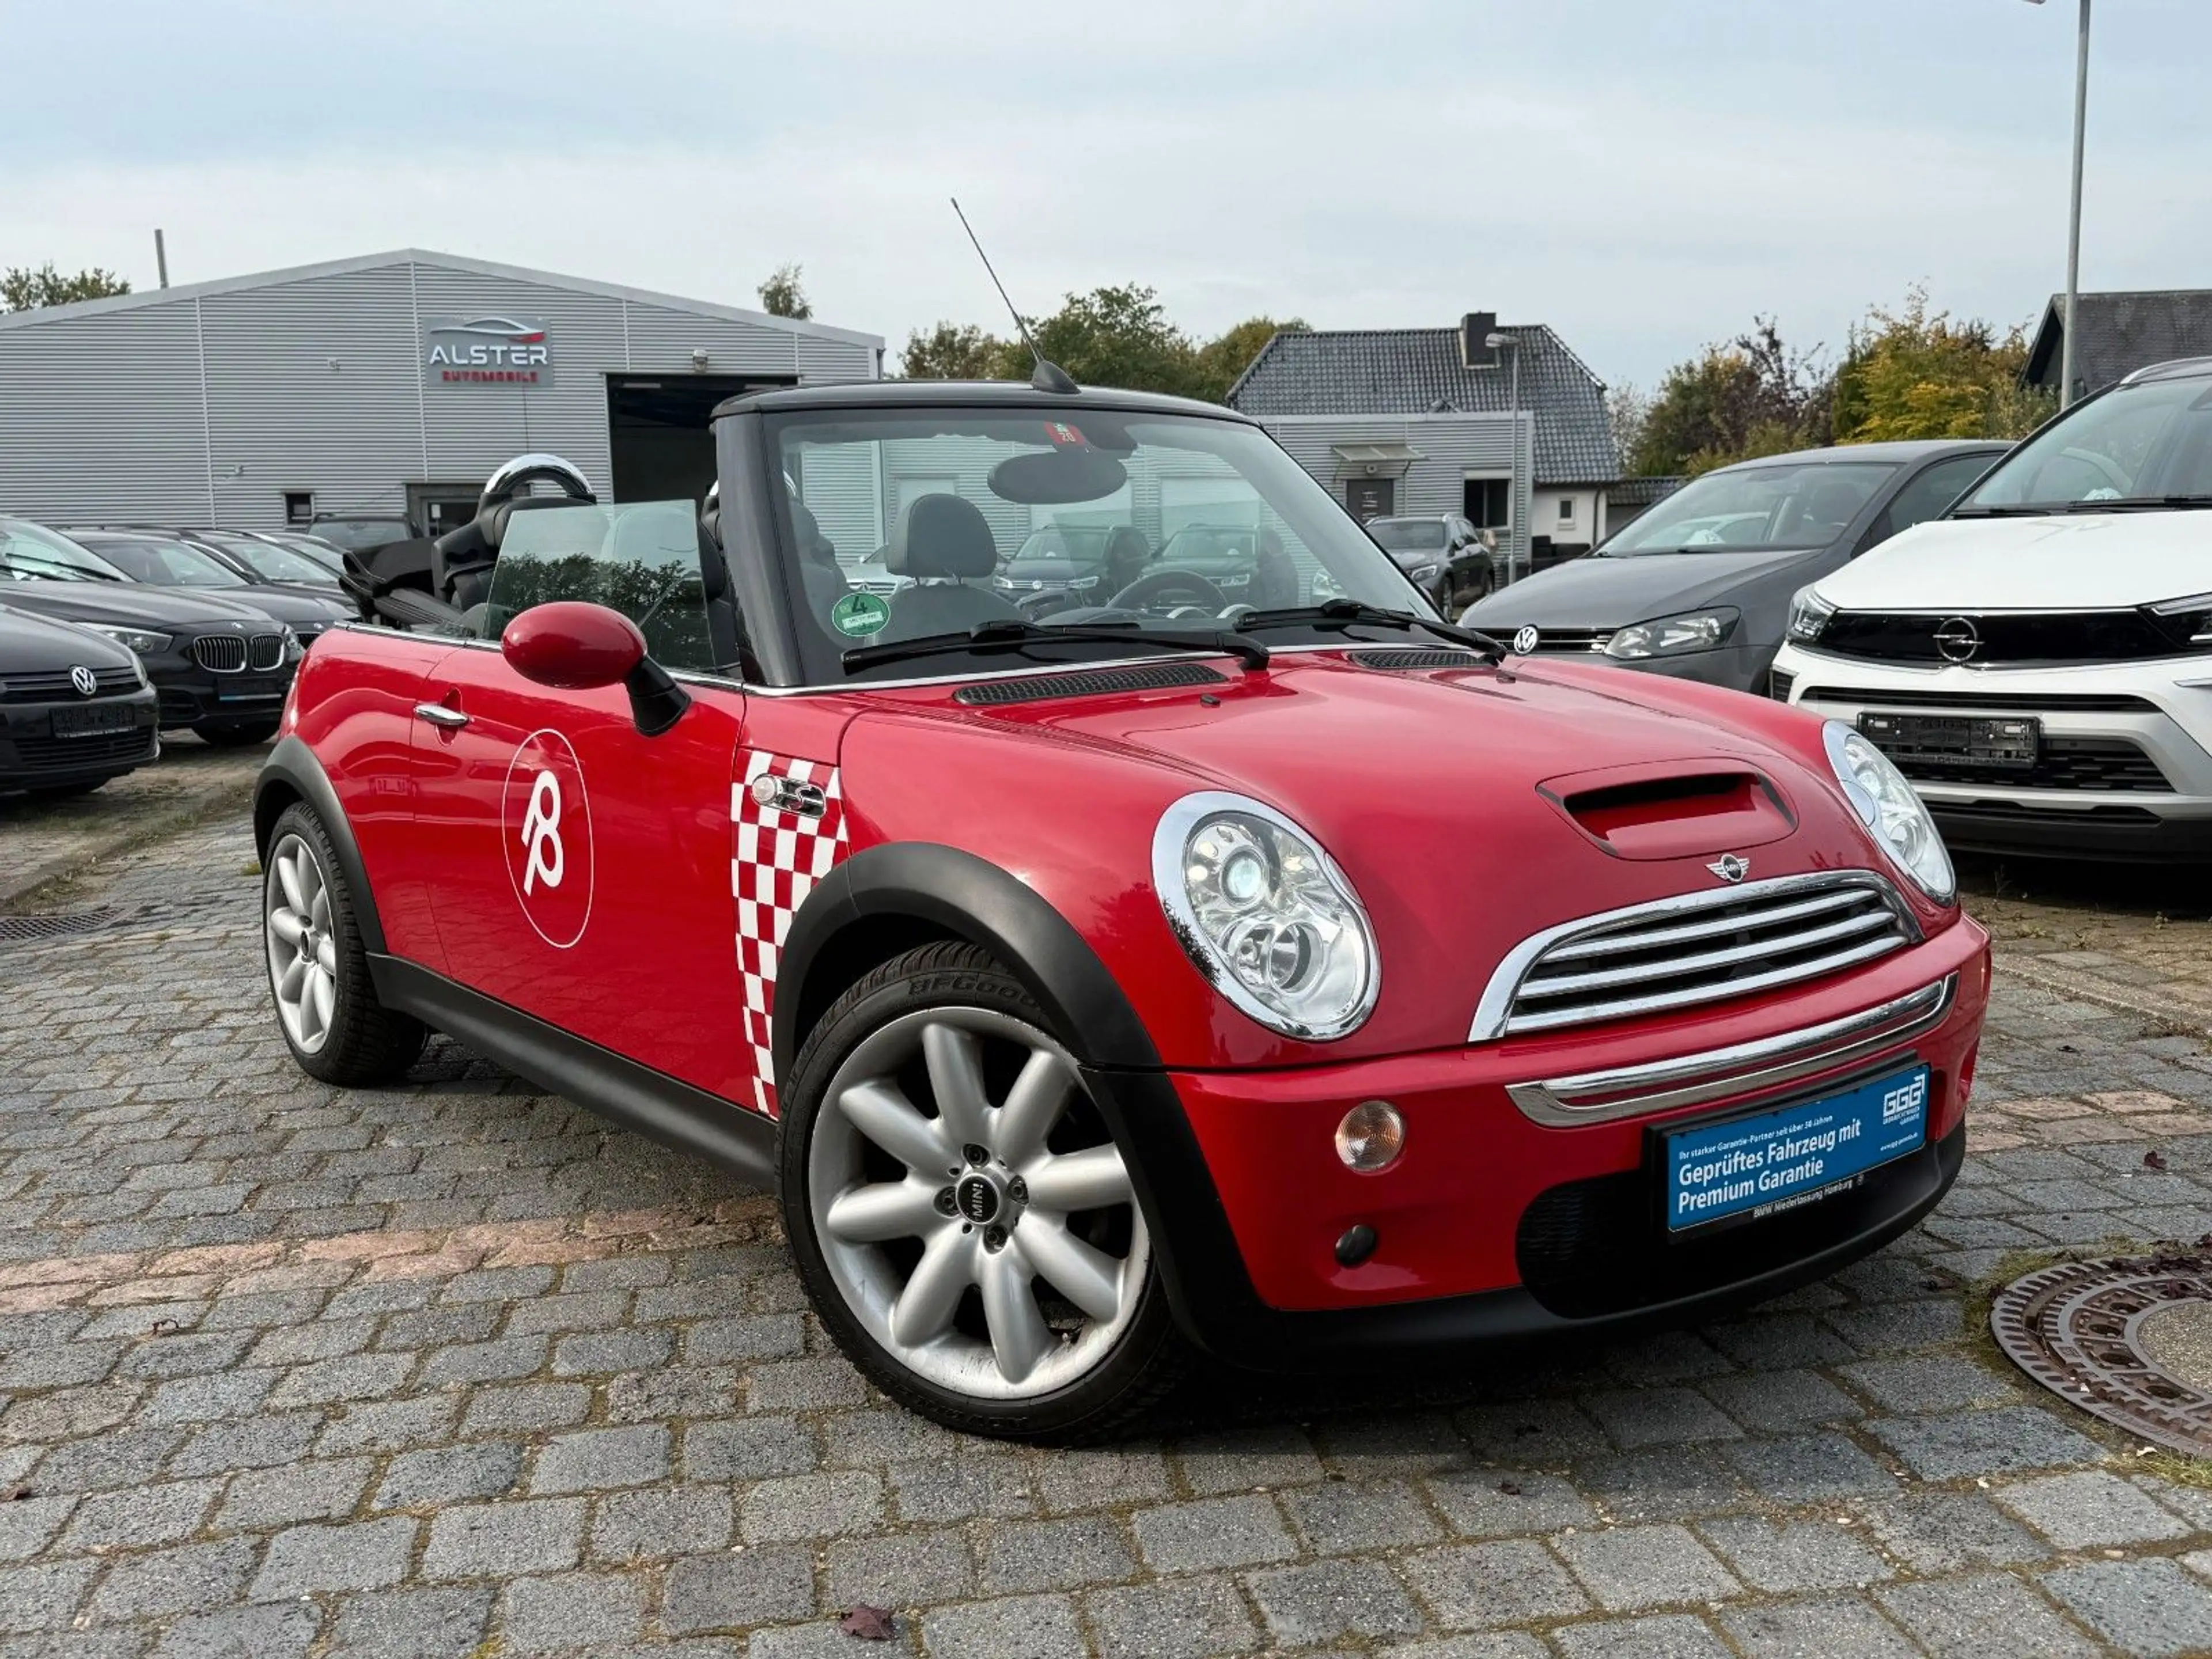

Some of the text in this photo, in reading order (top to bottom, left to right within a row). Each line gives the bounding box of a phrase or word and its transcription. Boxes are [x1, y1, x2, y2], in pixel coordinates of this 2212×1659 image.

[430, 345, 548, 365] ALSTER
[442, 370, 538, 382] AUTOMOBILE
[852, 596, 868, 613] 4
[1679, 1151, 1690, 1160] Ihr
[1691, 1145, 1716, 1157] starker
[1679, 1118, 1861, 1187] Geprüftes Fahrzeug mit
[1678, 1157, 1824, 1214] Premium Garantie
[1753, 1179, 1854, 1218] BMW Niederlassung Hamburg
[971, 1183, 984, 1218] MINI
